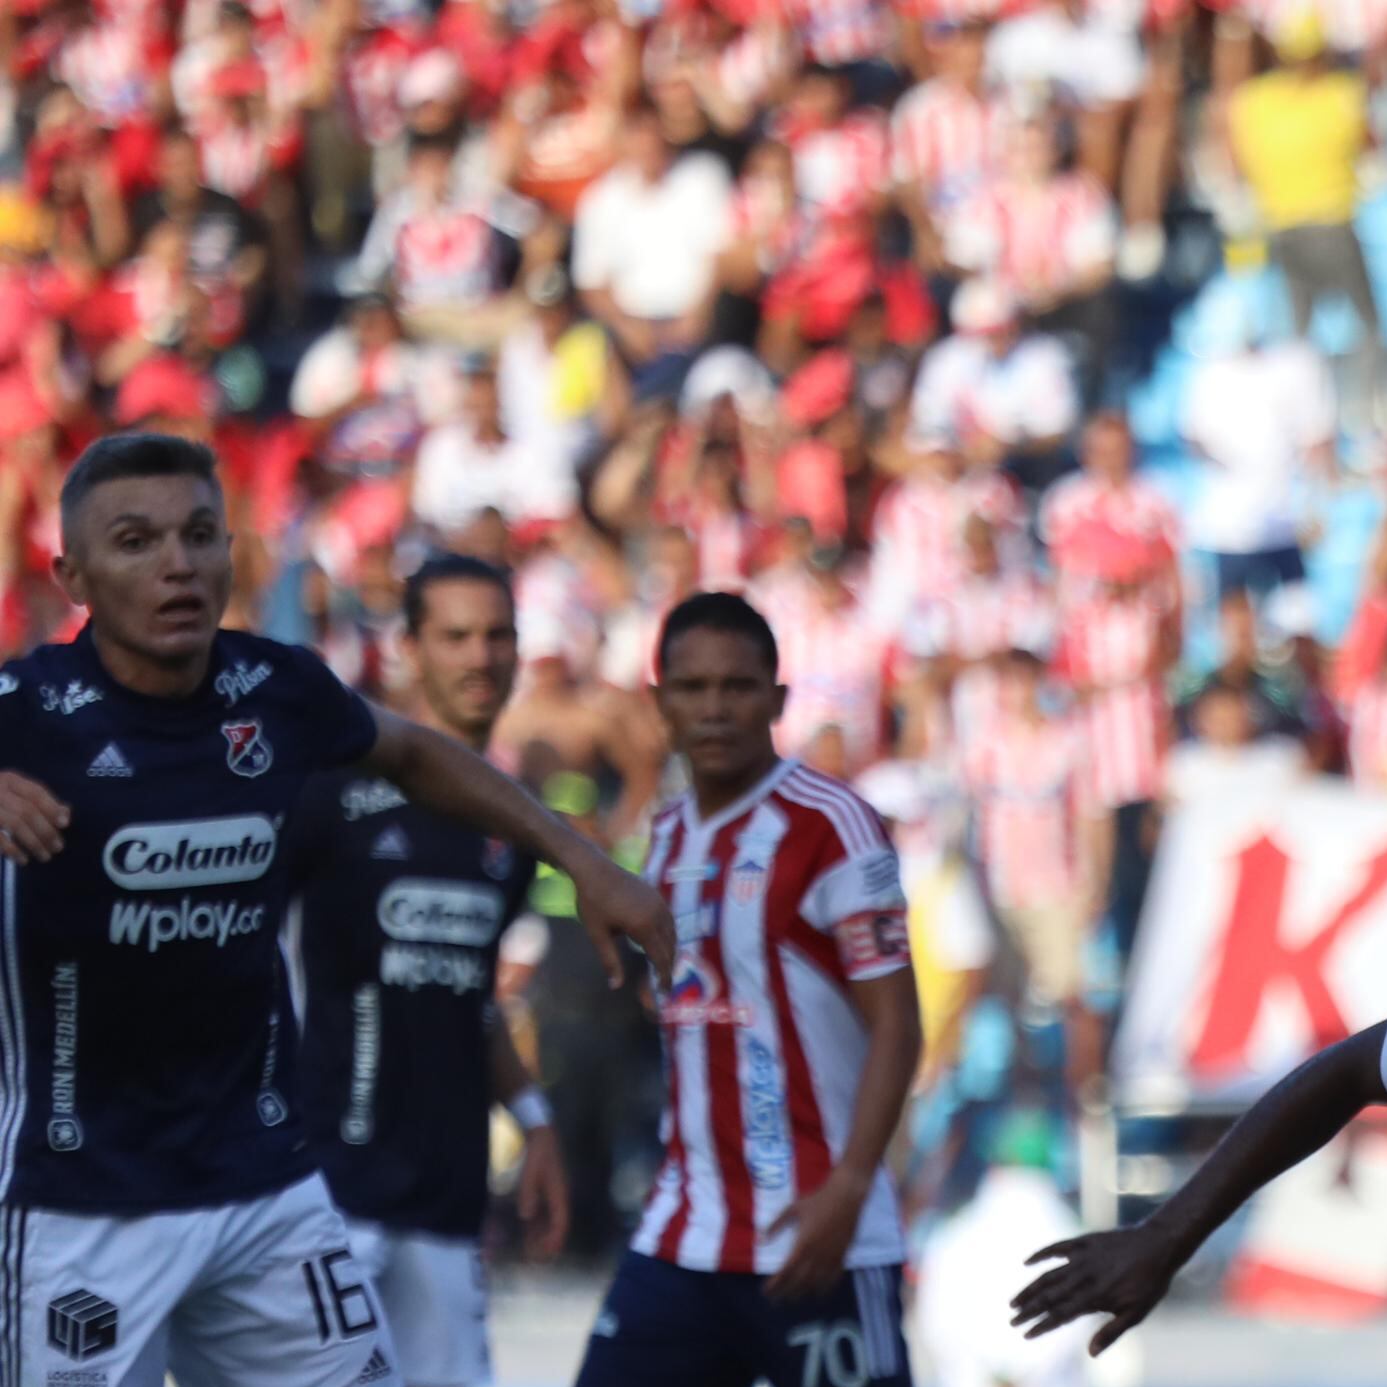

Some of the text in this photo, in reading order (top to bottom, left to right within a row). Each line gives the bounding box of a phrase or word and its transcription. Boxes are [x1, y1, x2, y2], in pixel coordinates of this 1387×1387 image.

[109, 834, 273, 866] Colanta
[52, 1072, 75, 1115] RON
[302, 1249, 378, 1345] 16
